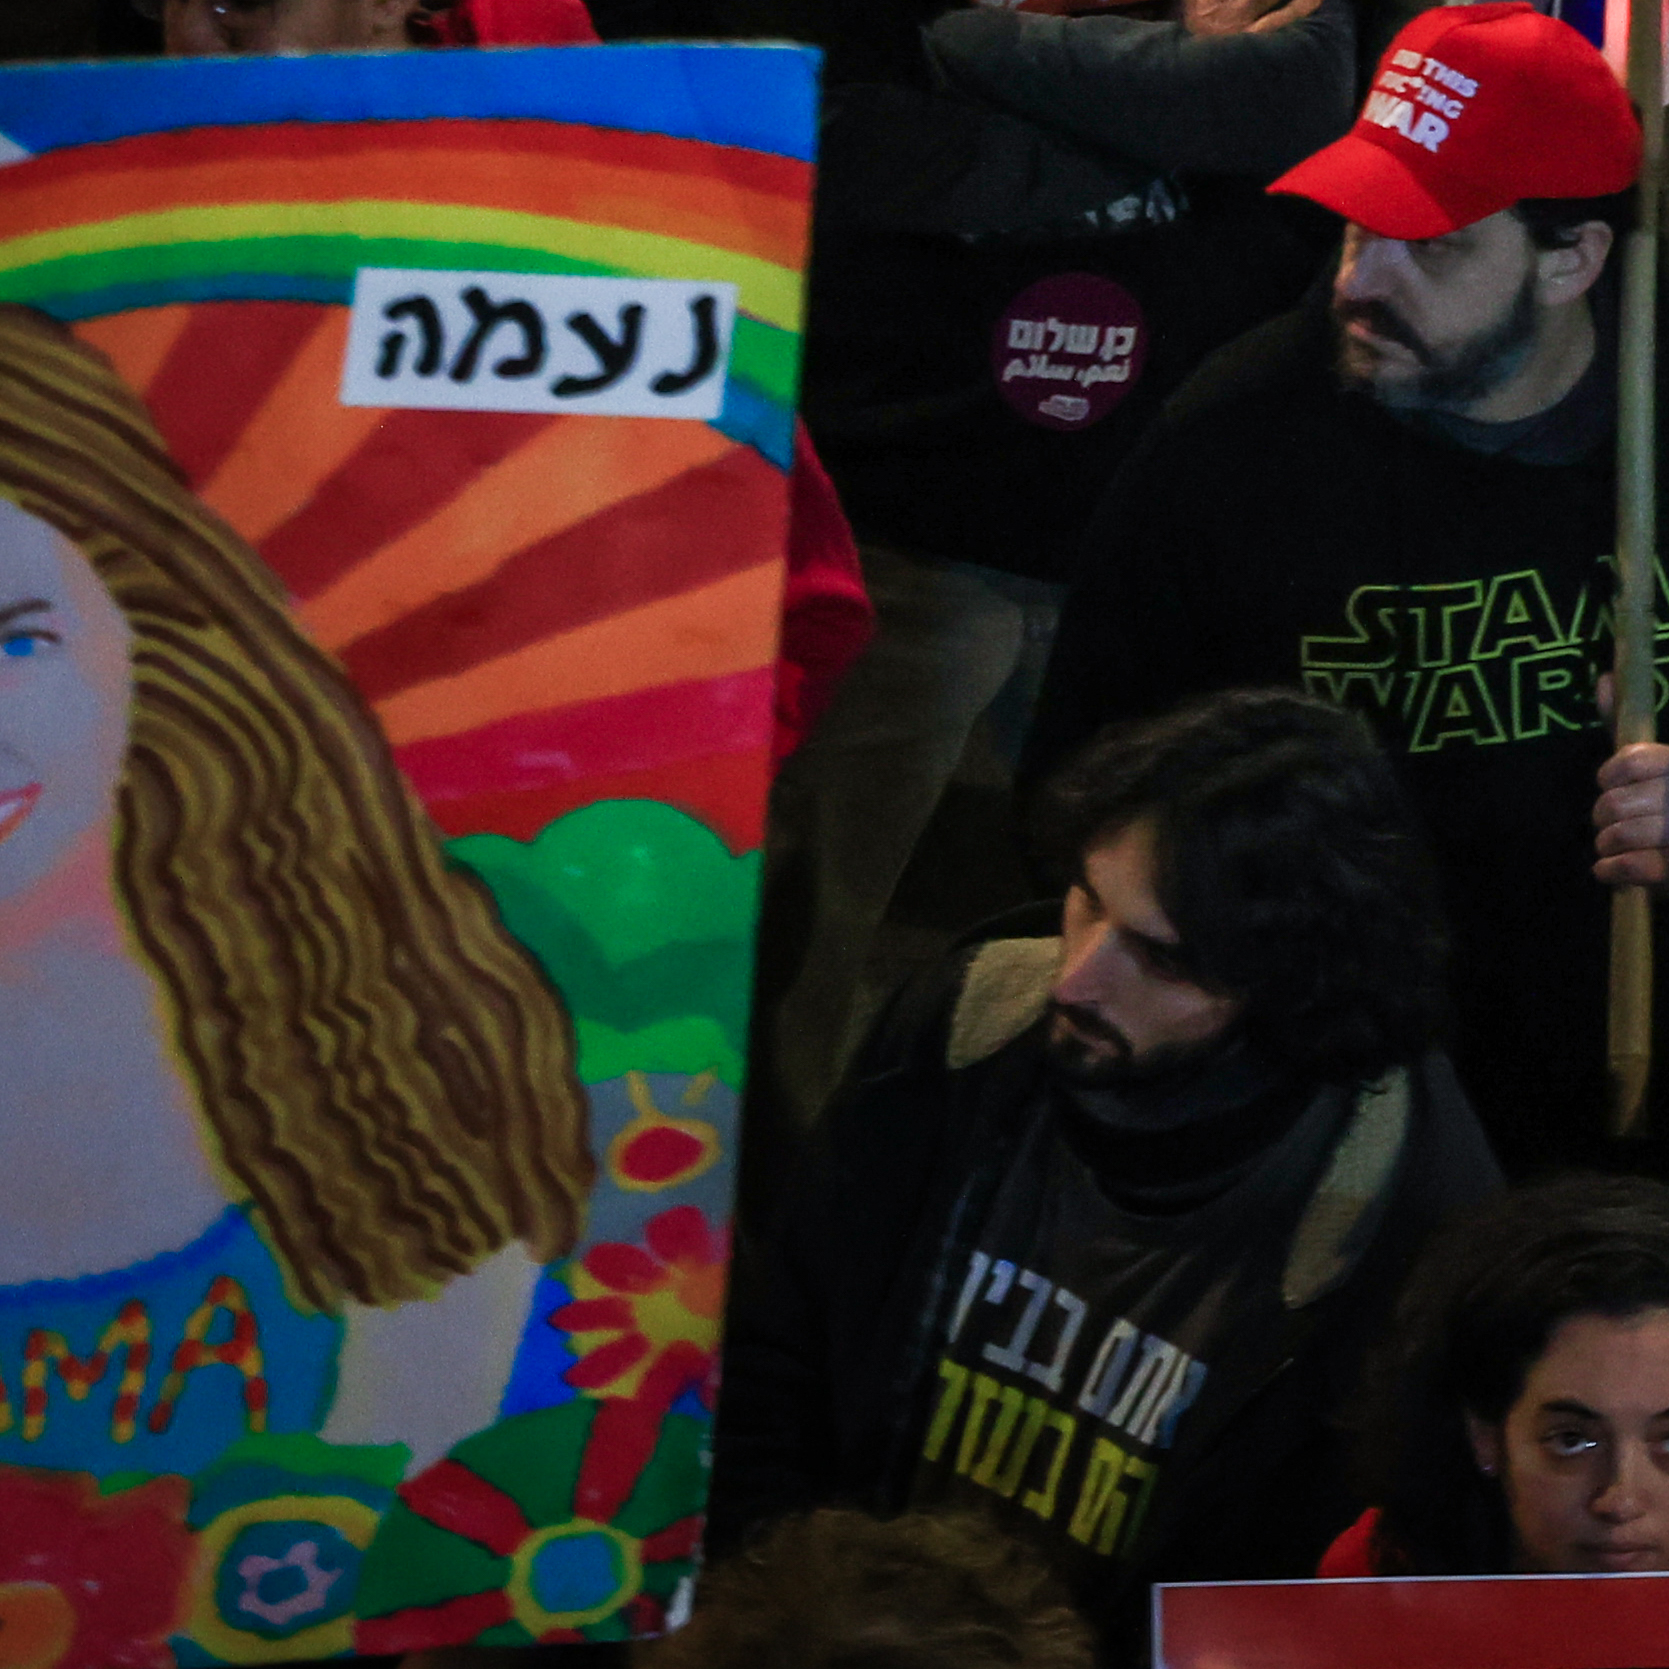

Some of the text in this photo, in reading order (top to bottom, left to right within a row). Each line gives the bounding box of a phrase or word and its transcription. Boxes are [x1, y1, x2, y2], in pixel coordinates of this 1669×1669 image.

[1362, 88, 1450, 154] WAR
[375, 285, 717, 399] נעמה
[1007, 315, 1101, 356] שלום
[0, 1273, 269, 1445] MA
